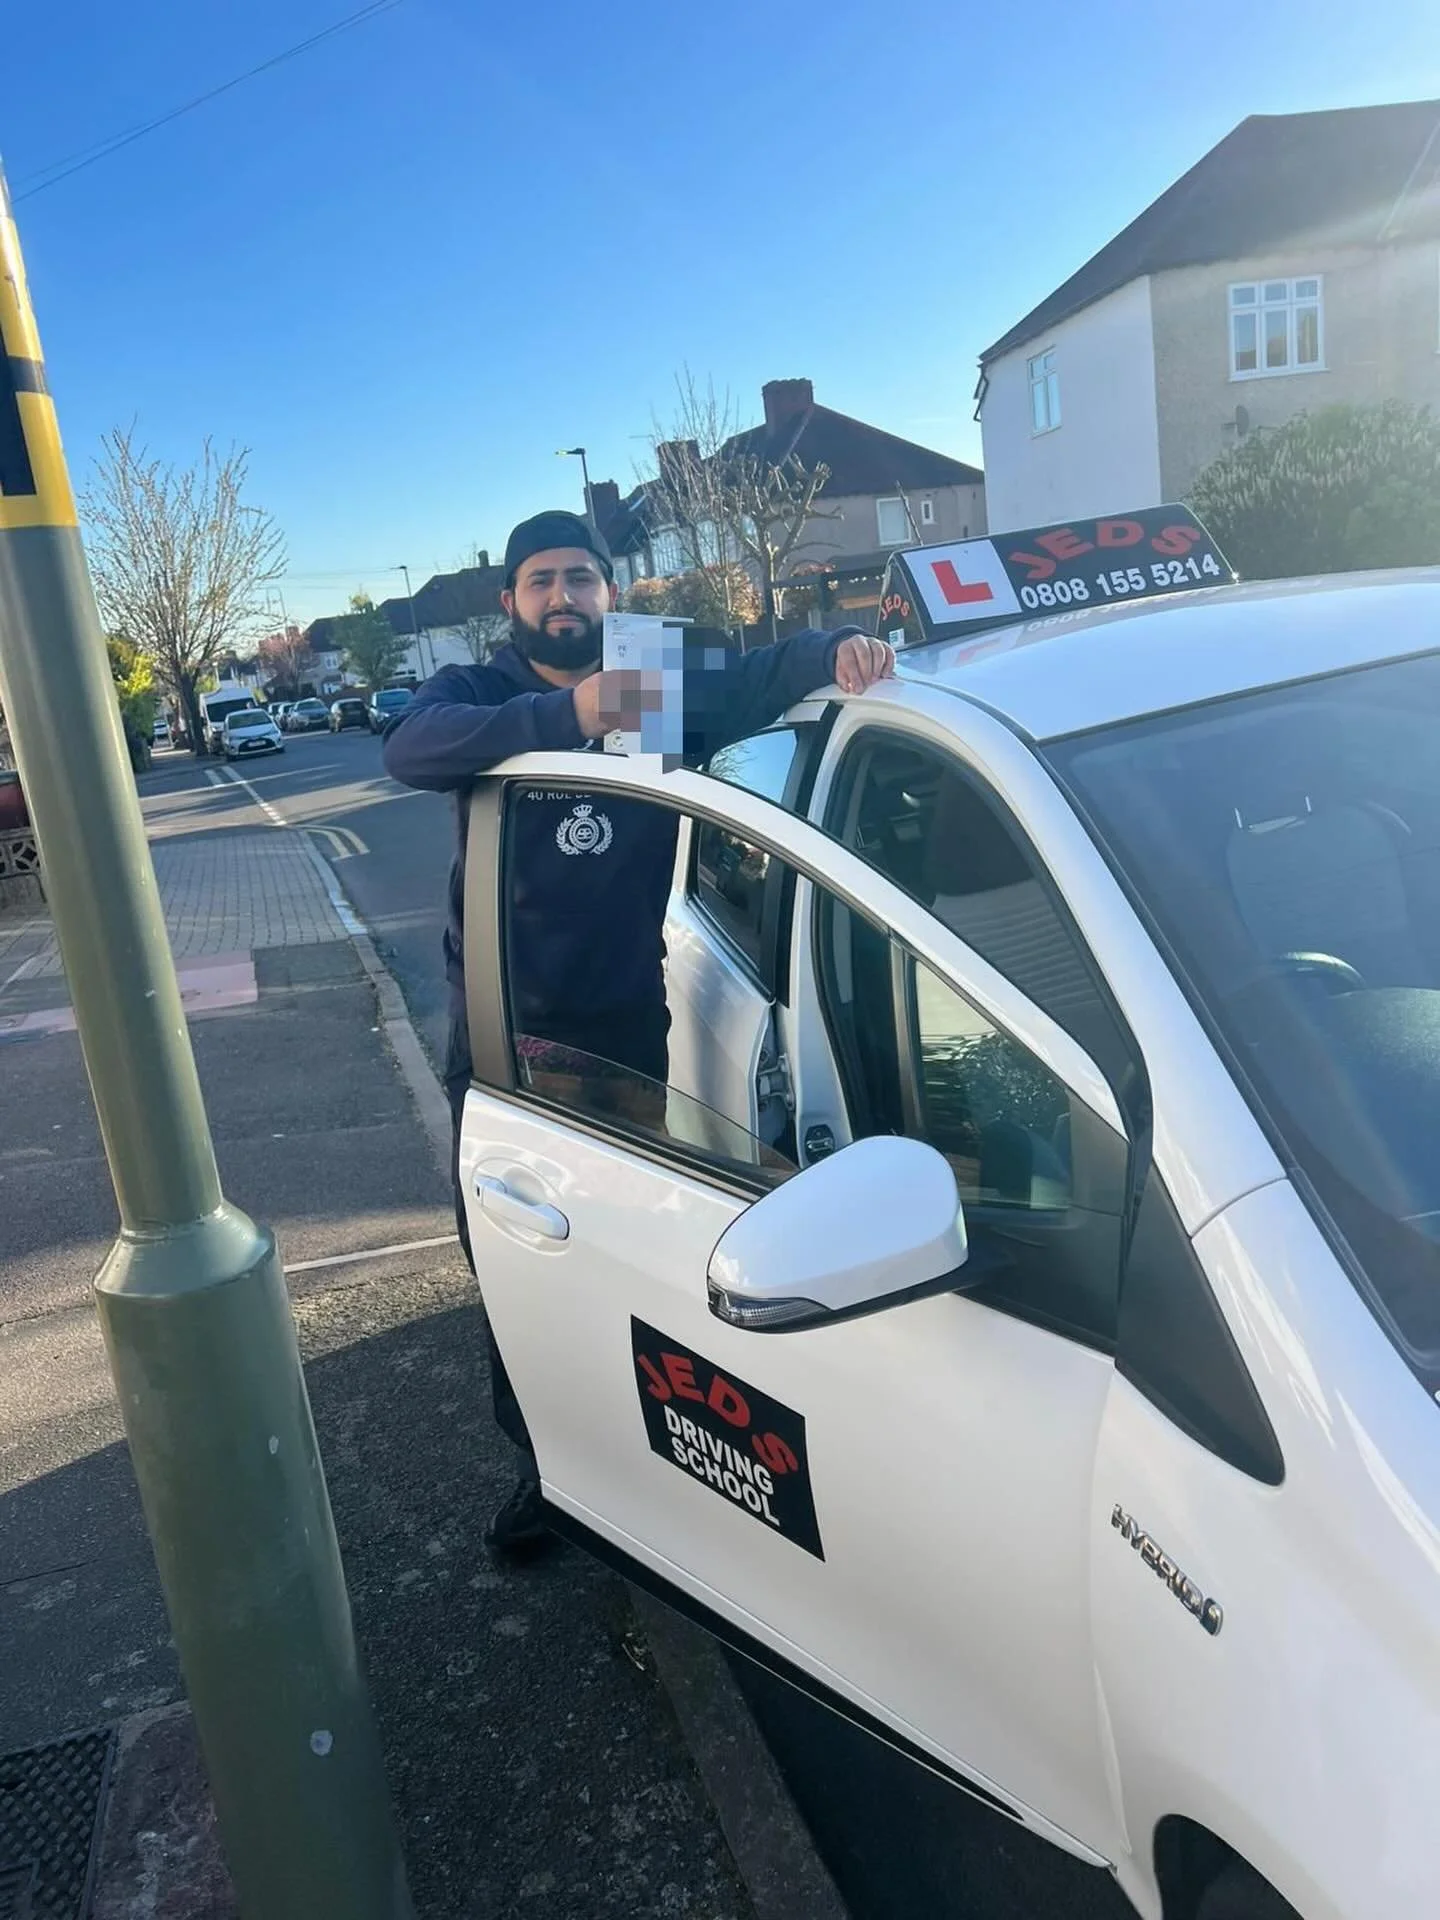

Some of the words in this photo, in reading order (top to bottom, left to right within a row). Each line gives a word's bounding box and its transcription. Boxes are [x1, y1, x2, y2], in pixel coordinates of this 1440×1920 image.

[1009, 520, 1200, 579] JEDS
[881, 593, 910, 621] JEDS
[930, 559, 994, 605] L
[1021, 577, 1090, 609] 0808
[1096, 565, 1147, 597] 155
[1153, 553, 1221, 587] 5214
[637, 1352, 798, 1474] JEDS
[664, 1404, 774, 1495] DRIVING
[671, 1436, 781, 1526] SCHOOL
